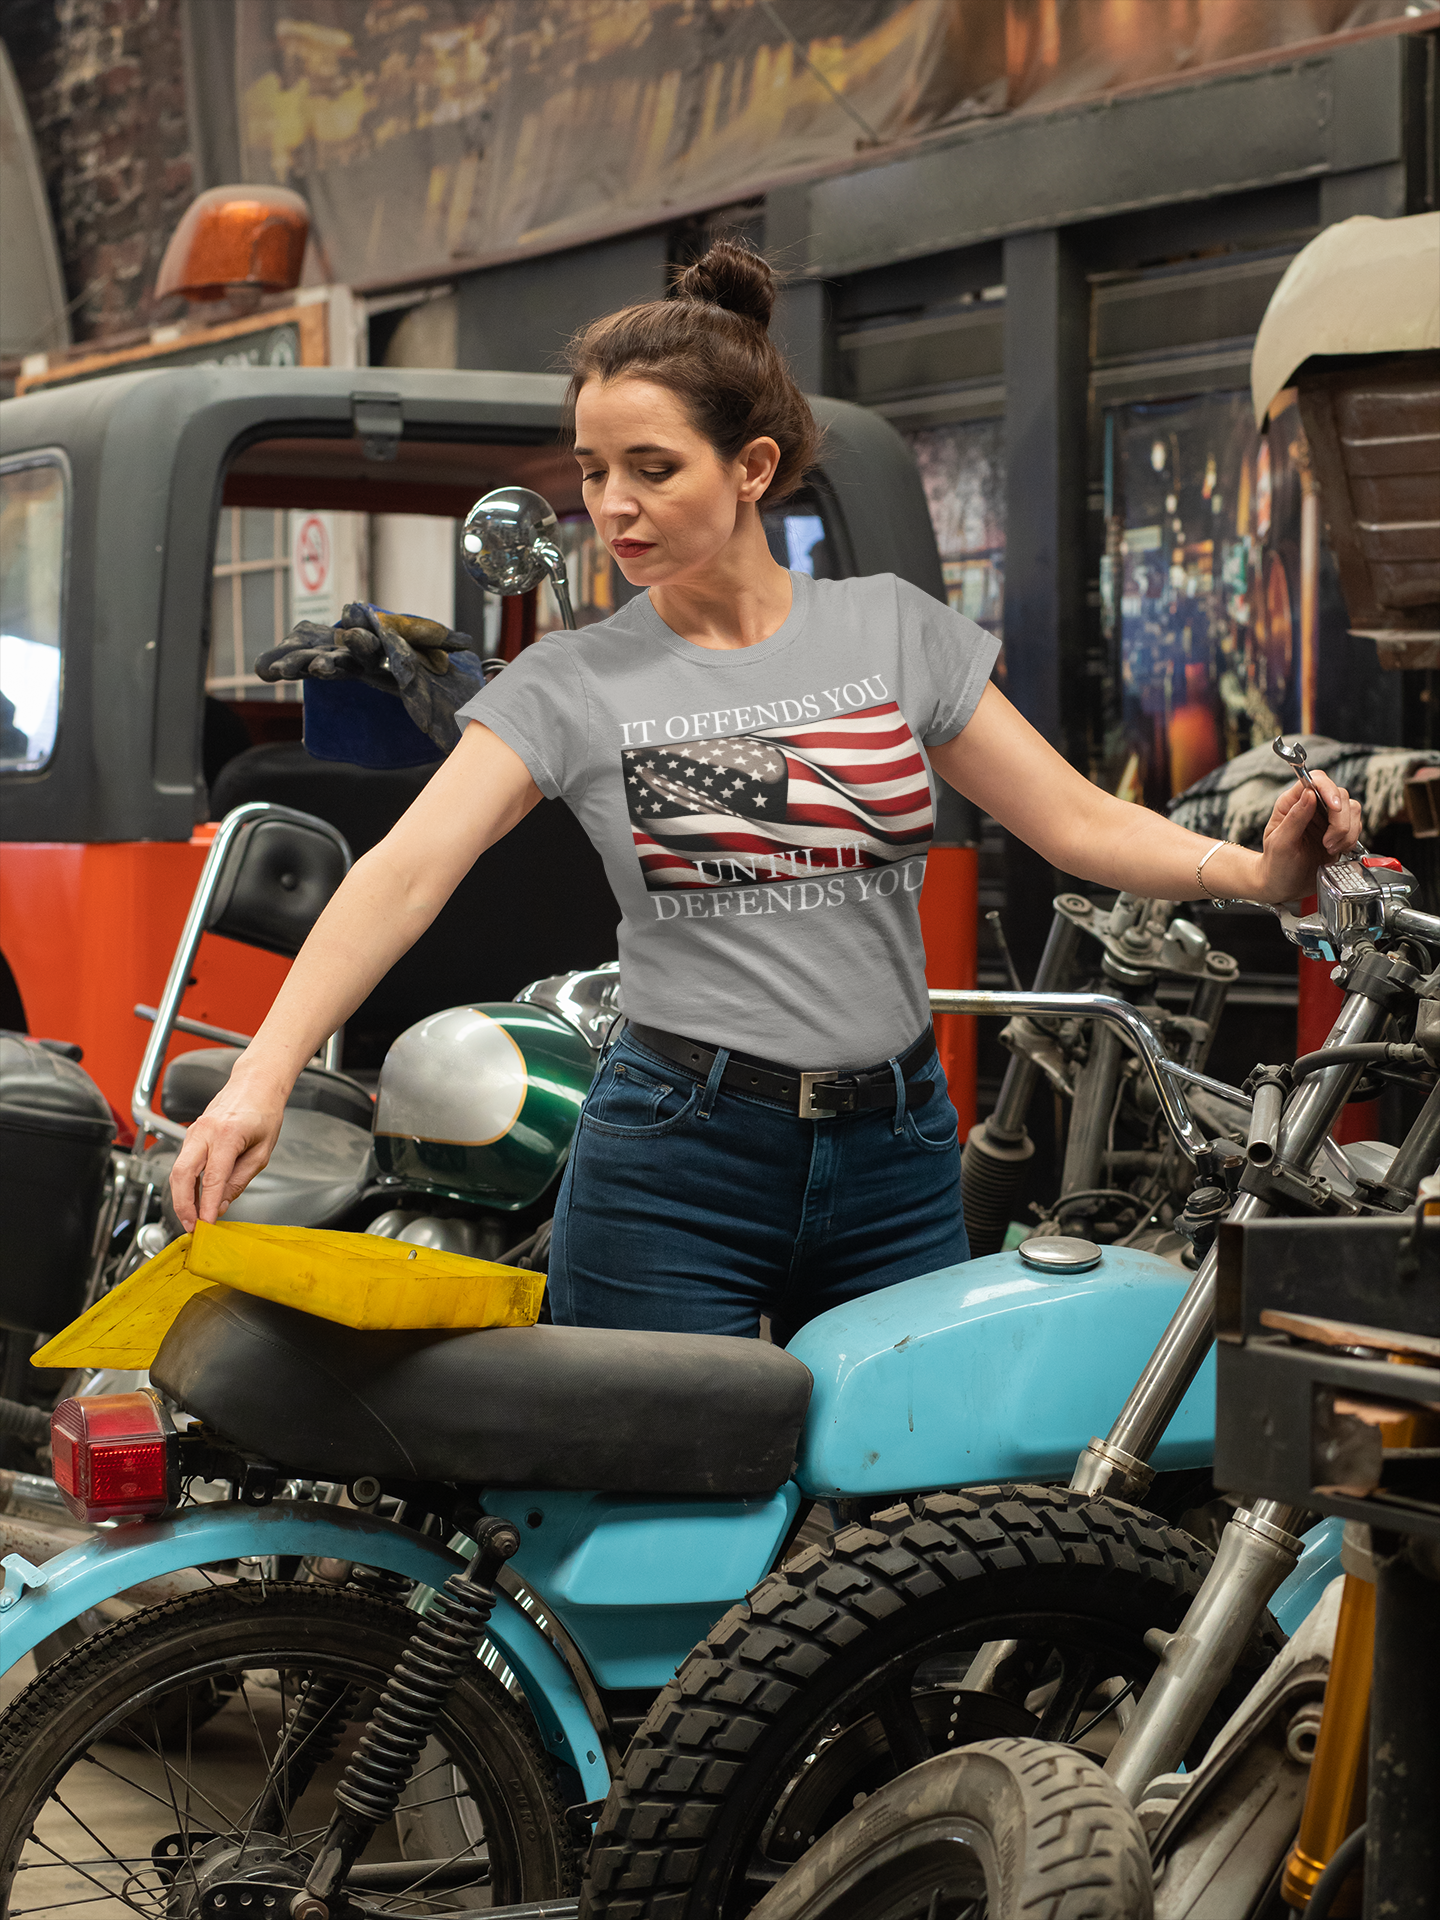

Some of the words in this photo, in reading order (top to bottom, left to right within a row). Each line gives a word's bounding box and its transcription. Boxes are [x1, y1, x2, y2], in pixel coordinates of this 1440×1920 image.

[619, 719, 656, 747] IT
[665, 694, 820, 739] OFFENDS
[822, 674, 889, 713] YOU
[651, 877, 846, 921] DEFENDS
[854, 859, 928, 902] YOU
[692, 847, 826, 885] UNTIL
[828, 839, 868, 870] IT
